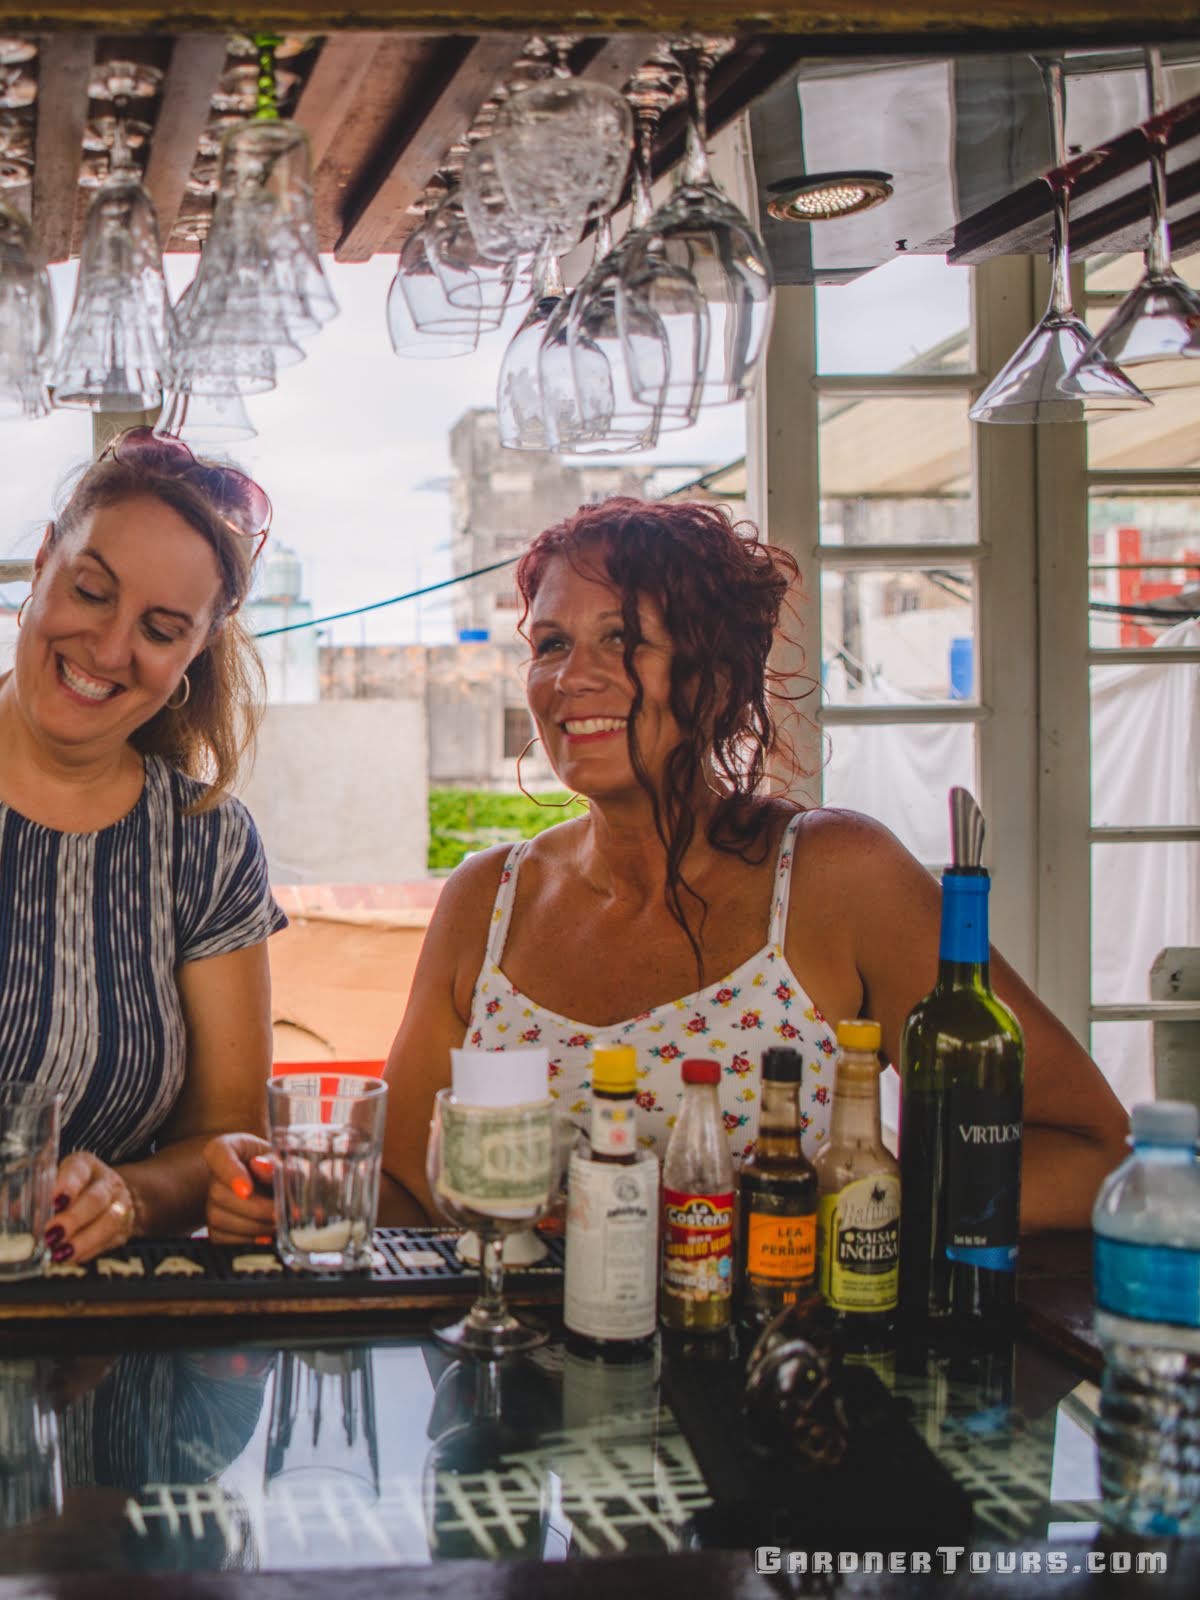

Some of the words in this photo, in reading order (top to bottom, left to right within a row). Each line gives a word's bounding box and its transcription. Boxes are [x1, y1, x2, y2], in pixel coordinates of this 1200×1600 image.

[691, 1202, 709, 1214] La
[778, 1227, 803, 1239] LEA
[856, 1230, 891, 1244] SALSA
